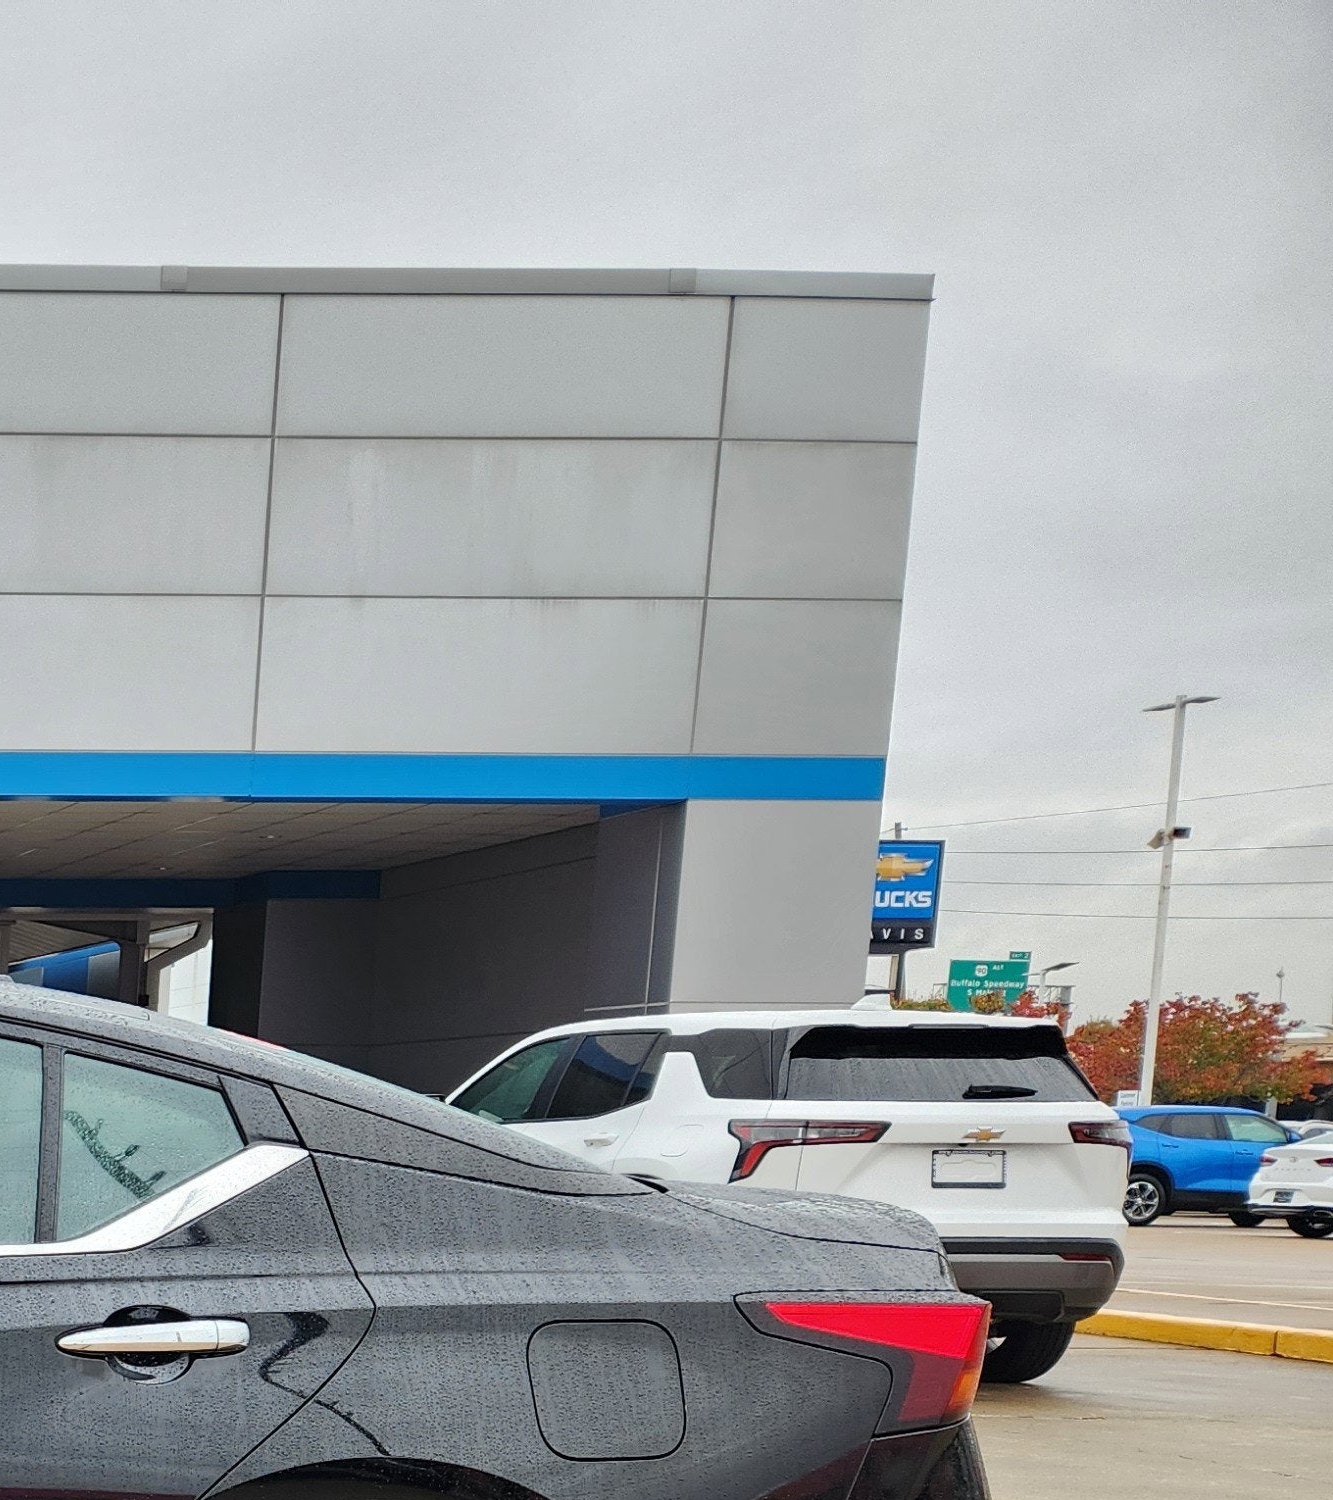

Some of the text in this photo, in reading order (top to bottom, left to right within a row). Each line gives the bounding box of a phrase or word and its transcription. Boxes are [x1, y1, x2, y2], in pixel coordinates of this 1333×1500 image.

[950, 979, 1025, 989] Buffalo Speedway
[967, 988, 973, 996] S
